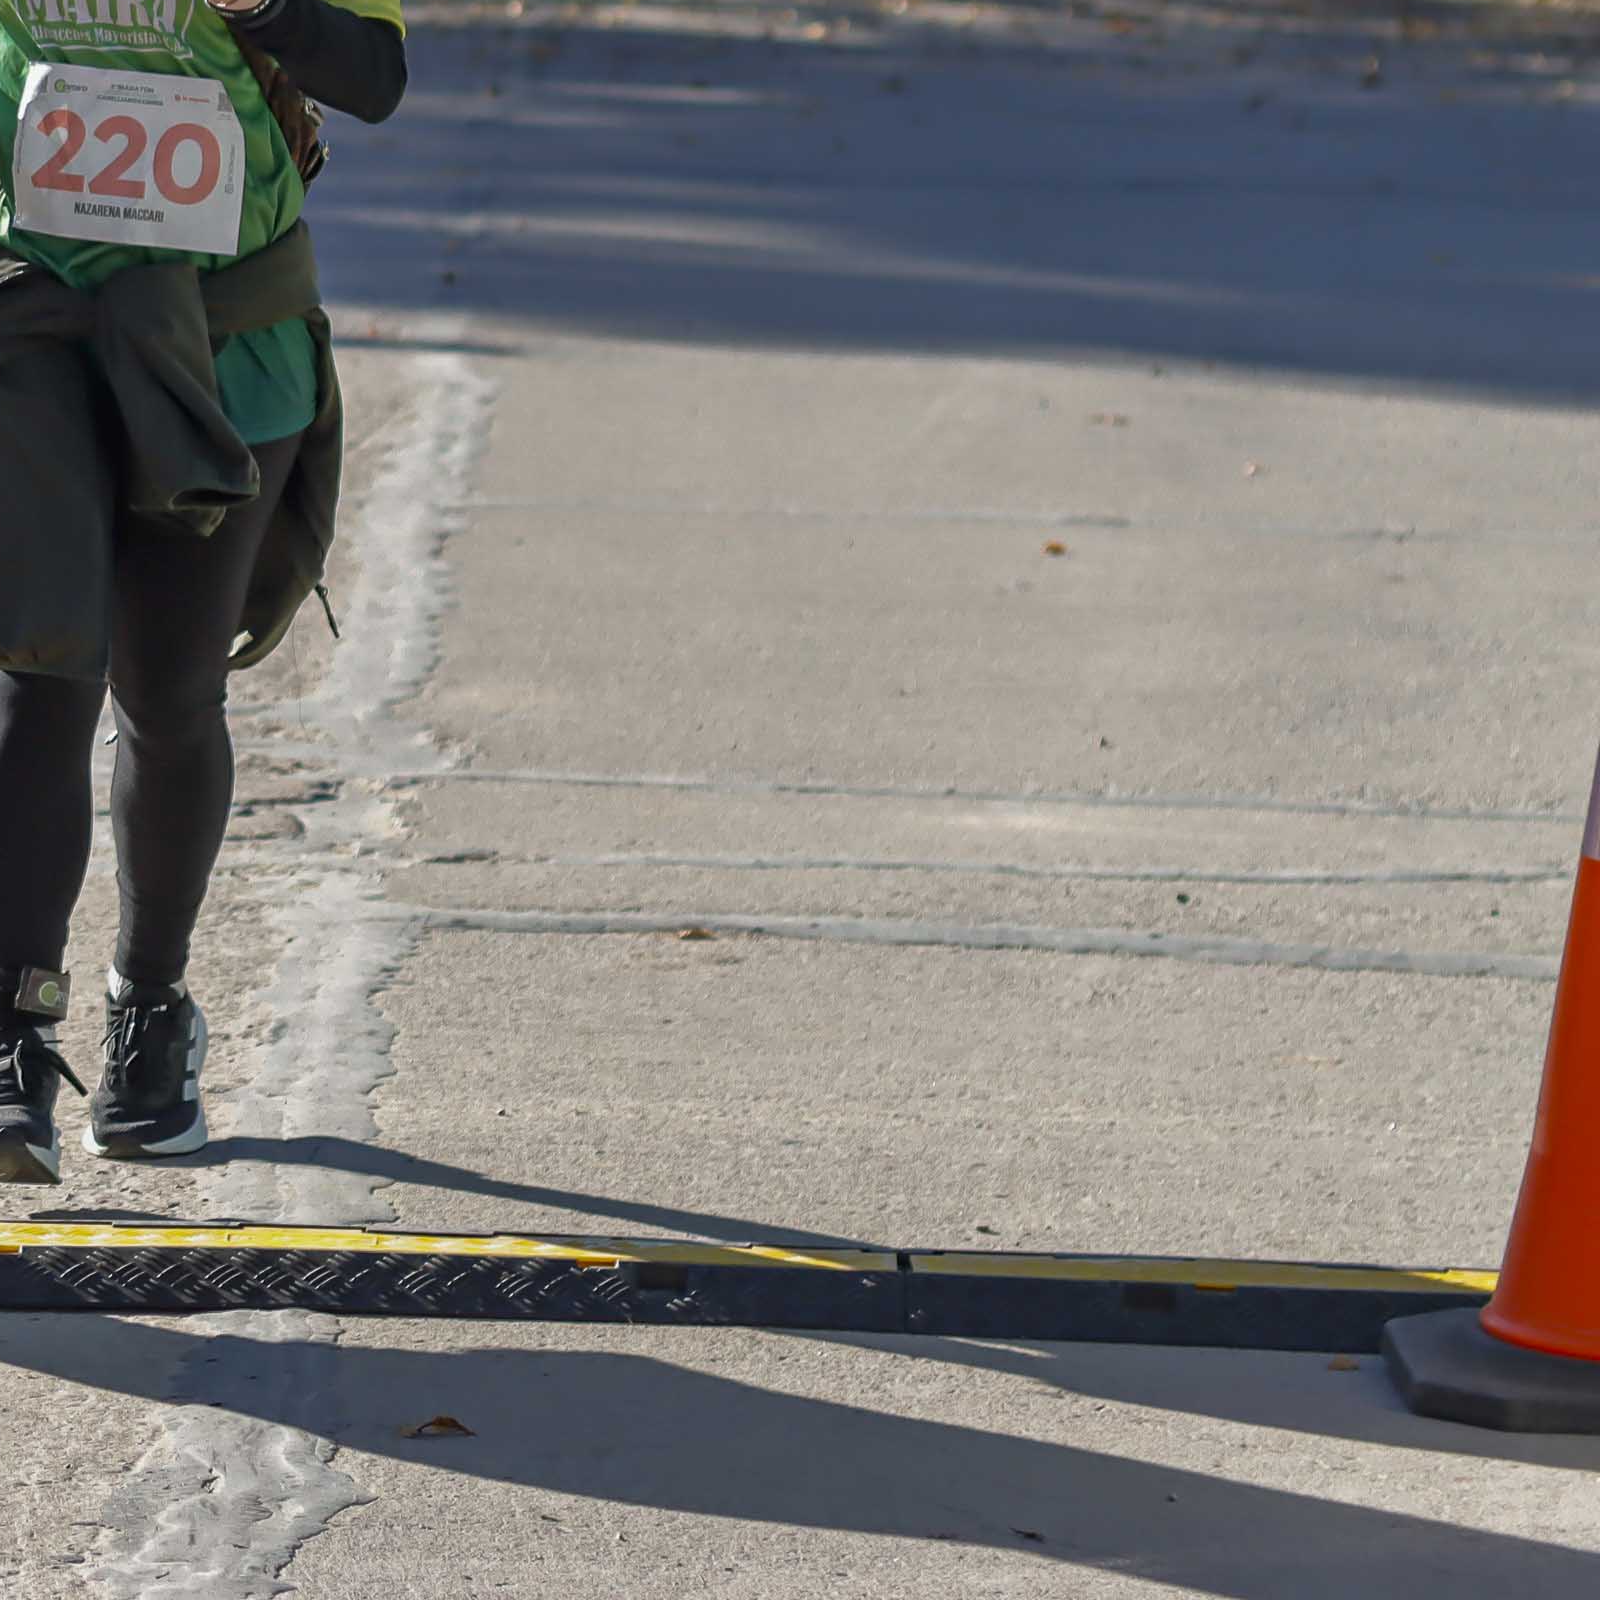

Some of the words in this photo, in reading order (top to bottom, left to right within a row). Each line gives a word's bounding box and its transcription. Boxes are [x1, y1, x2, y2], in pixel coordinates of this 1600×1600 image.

[30, 108, 222, 206] 220
[73, 201, 122, 220] NAZARENA
[123, 207, 164, 224] MACCARI
